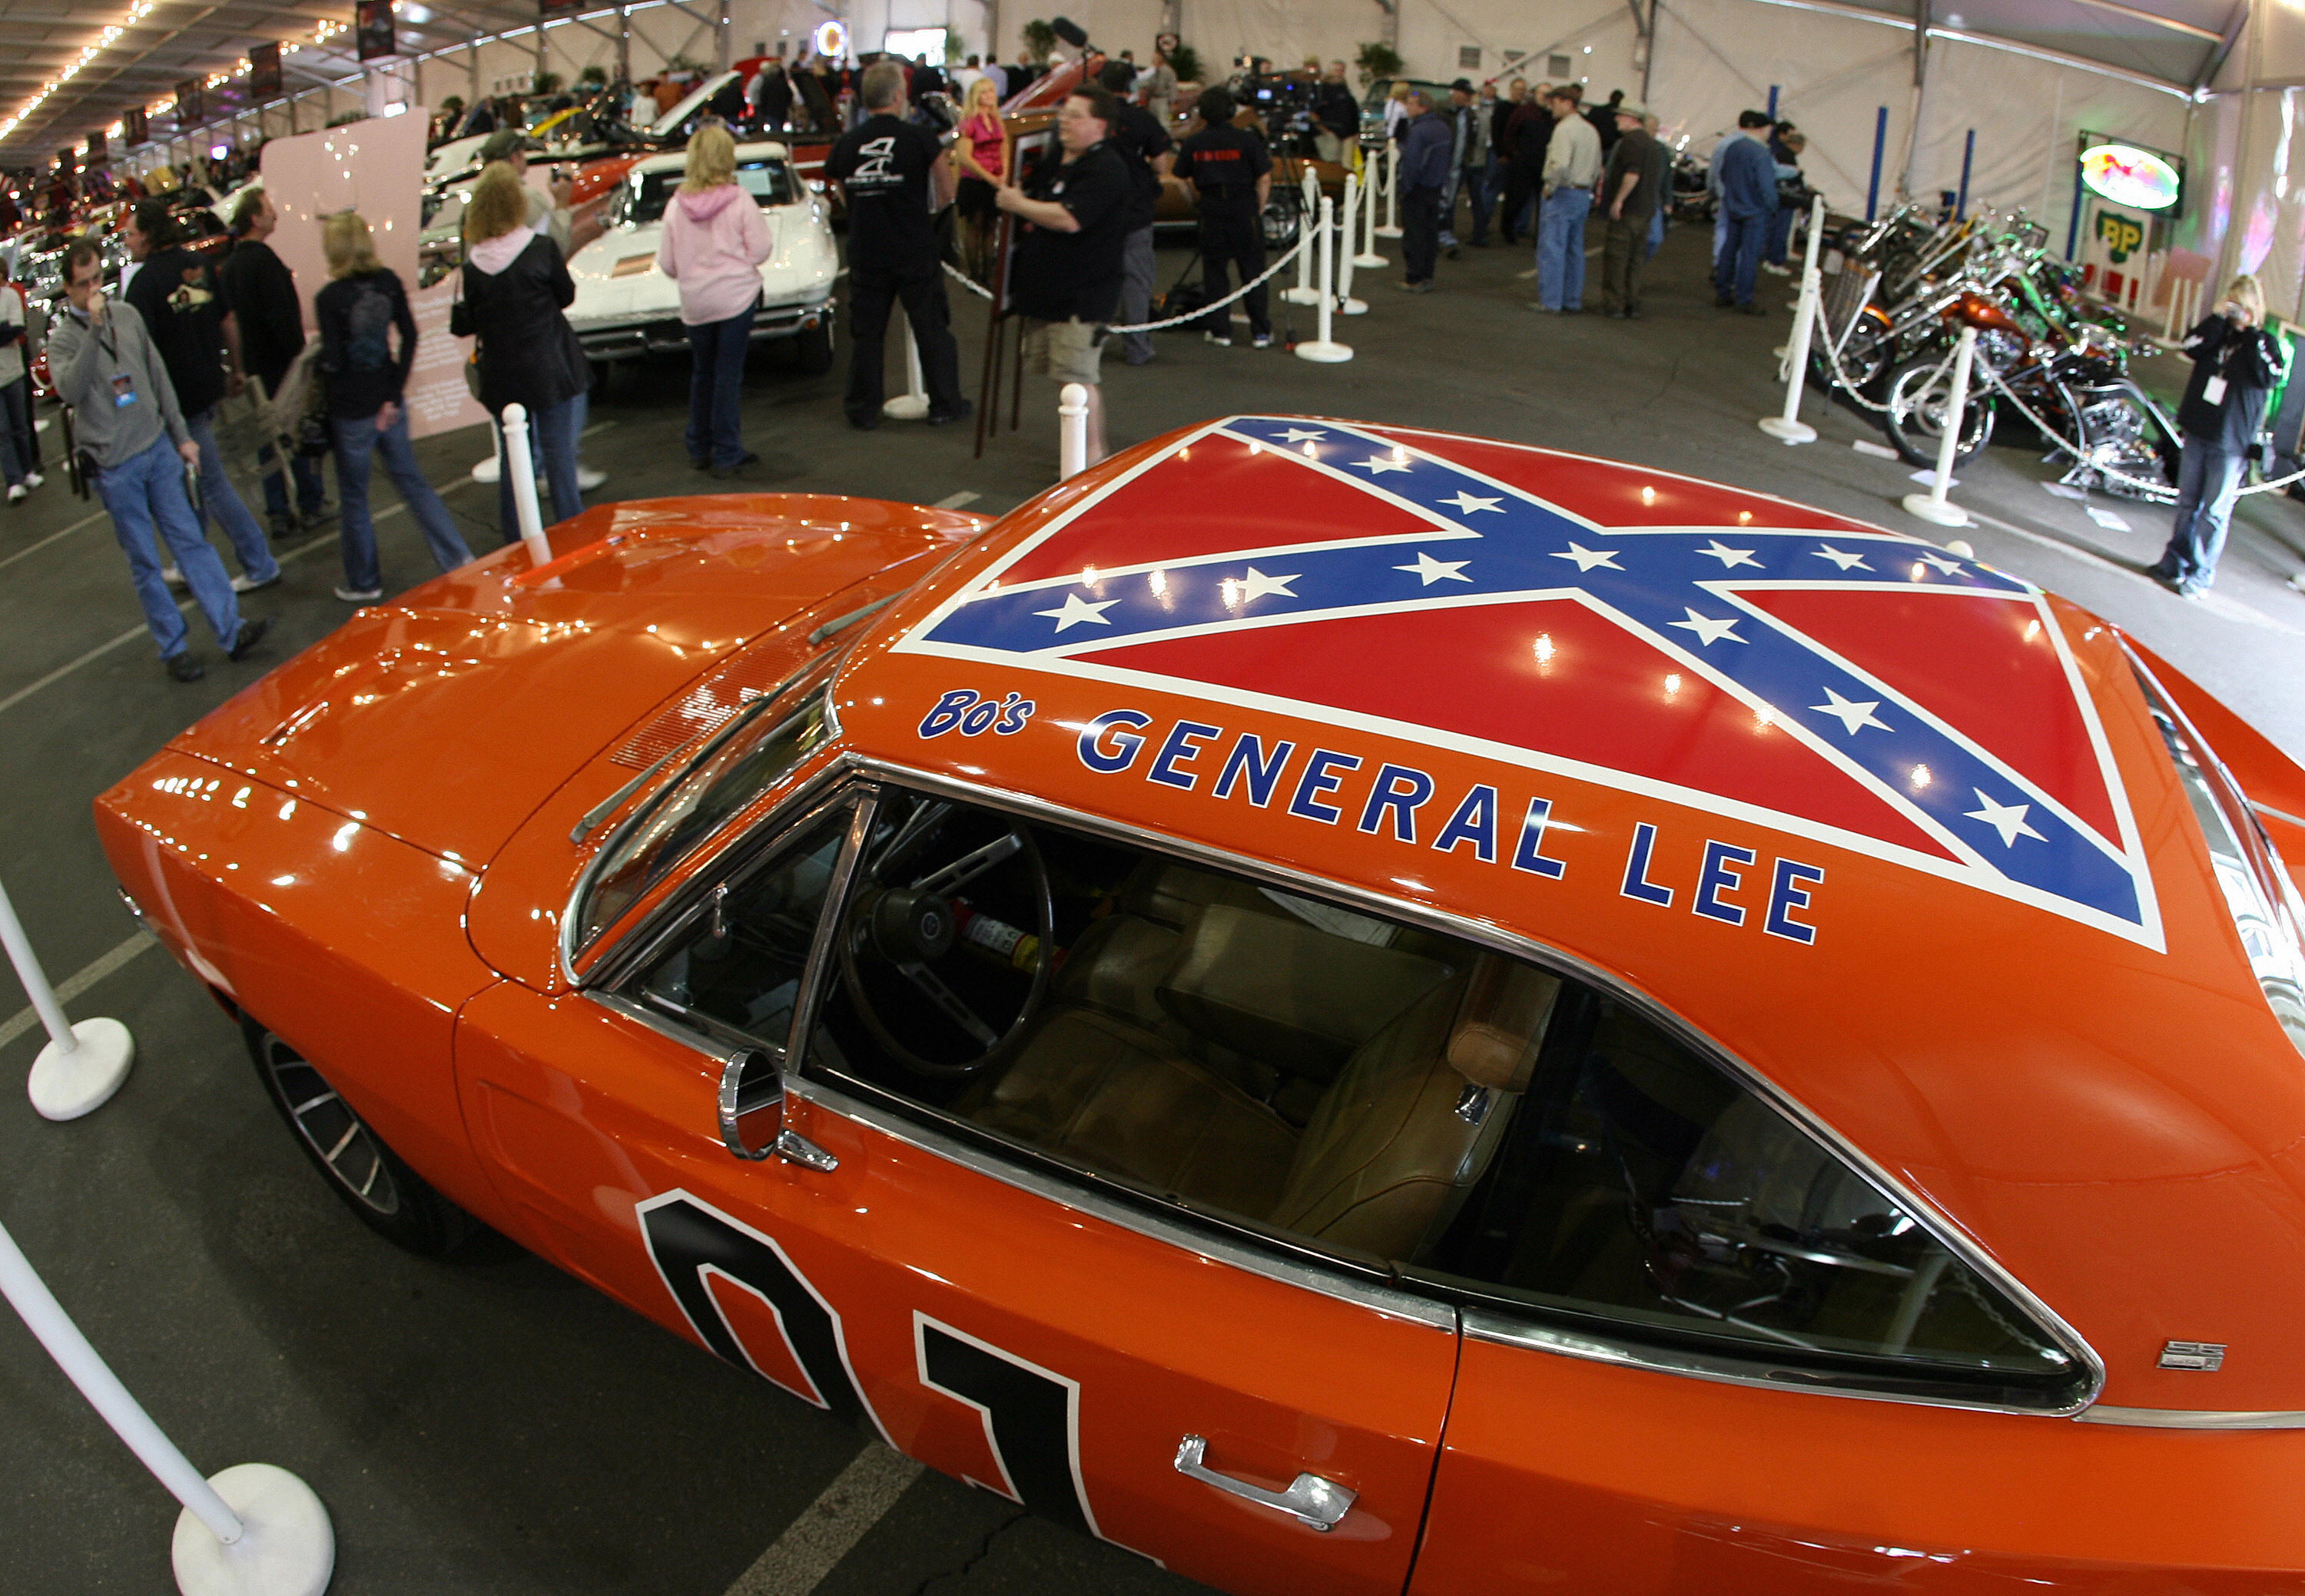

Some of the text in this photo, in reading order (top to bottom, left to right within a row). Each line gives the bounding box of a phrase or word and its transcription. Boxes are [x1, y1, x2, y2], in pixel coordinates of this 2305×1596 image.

[2102, 217, 2142, 255] BP
[917, 689, 1036, 739] Bo's
[1076, 708, 1825, 946] GENERAL LEE
